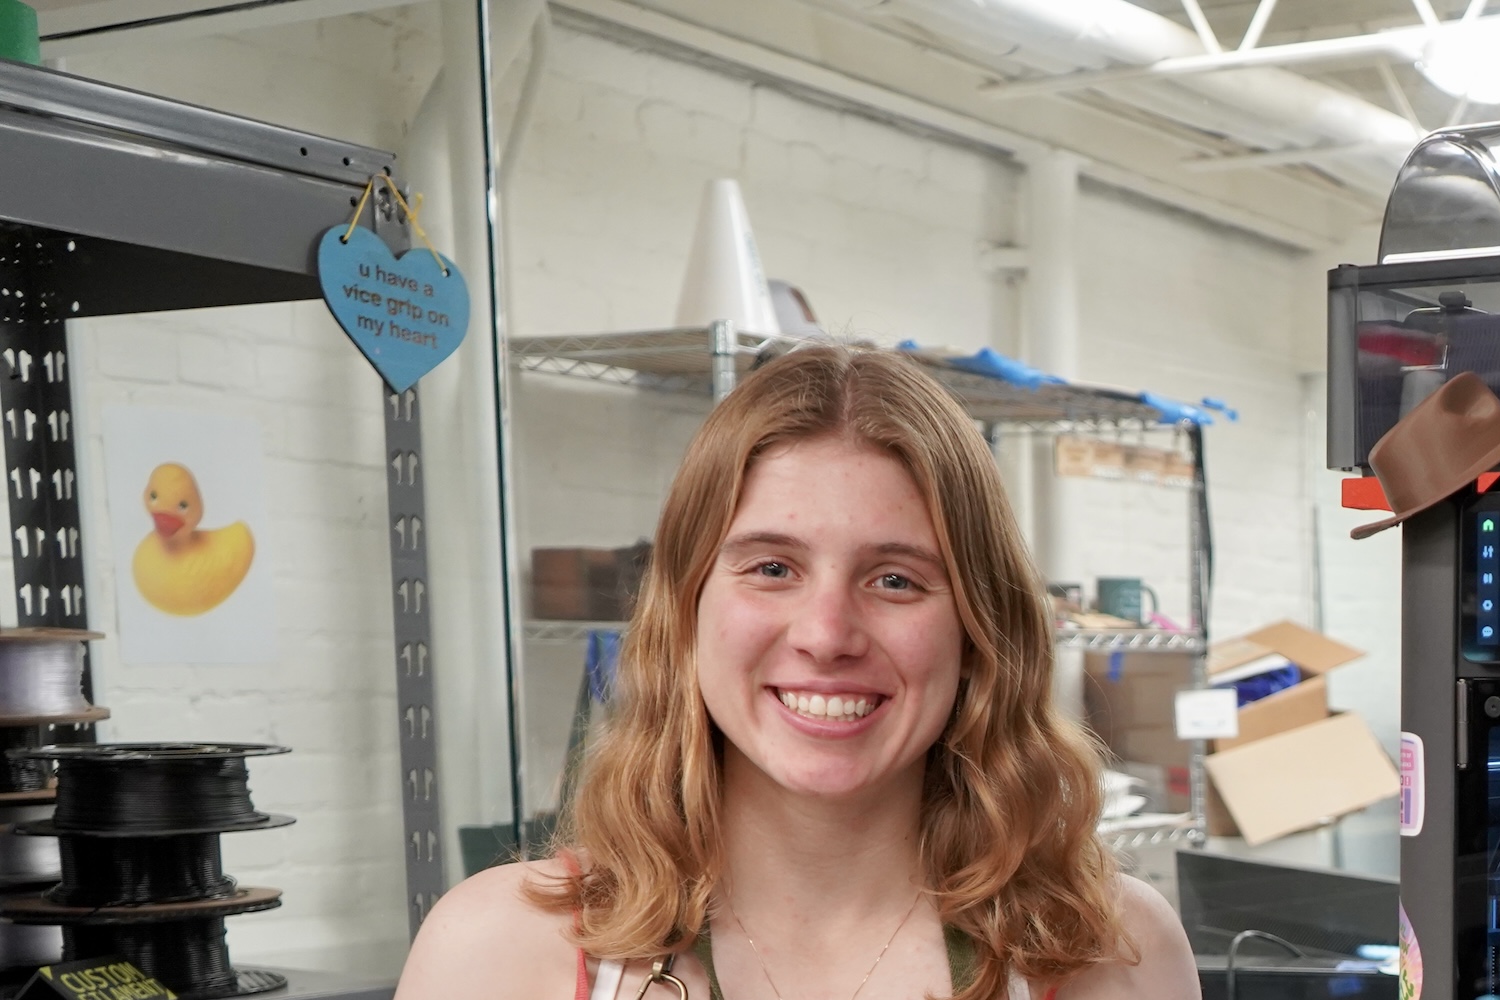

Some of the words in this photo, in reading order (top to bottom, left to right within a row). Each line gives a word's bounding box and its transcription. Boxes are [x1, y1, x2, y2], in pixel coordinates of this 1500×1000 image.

[359, 263, 370, 277] u
[375, 264, 418, 292] have
[423, 283, 434, 298] a
[342, 283, 382, 307] vice
[386, 297, 423, 320] grip
[428, 309, 450, 327] on
[356, 314, 385, 337] my
[389, 320, 438, 350] heart
[60, 961, 147, 994] CUSTOM
